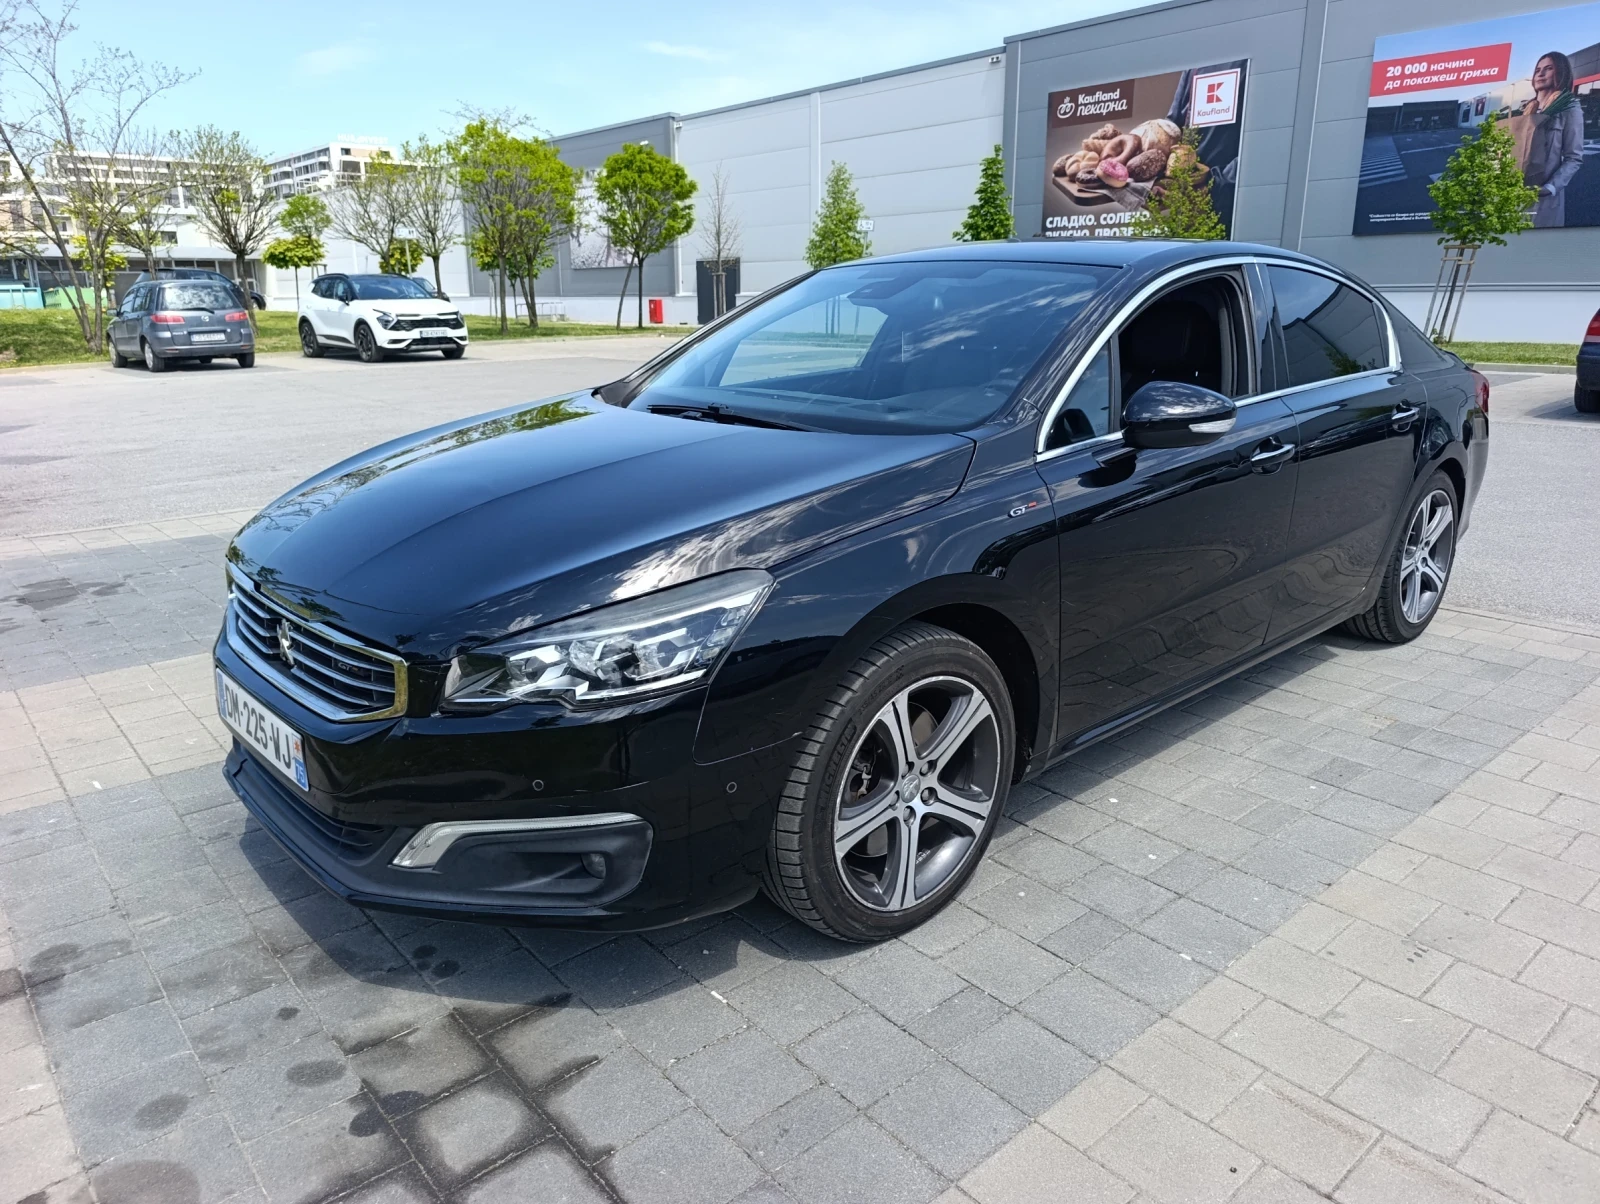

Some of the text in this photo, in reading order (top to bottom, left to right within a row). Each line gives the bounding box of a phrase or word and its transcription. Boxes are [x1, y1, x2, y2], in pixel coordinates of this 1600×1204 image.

[1386, 58, 1475, 77] 20 000 начина
[1384, 67, 1499, 90] да покажеш грижа
[1078, 88, 1120, 104] Kaufland
[1077, 99, 1128, 116] пекарна
[1197, 106, 1231, 117] Kaufland
[1046, 214, 1097, 229] СЛАДКО.
[1010, 504, 1028, 517] GT
[224, 683, 292, 770] DM-225-WJ
